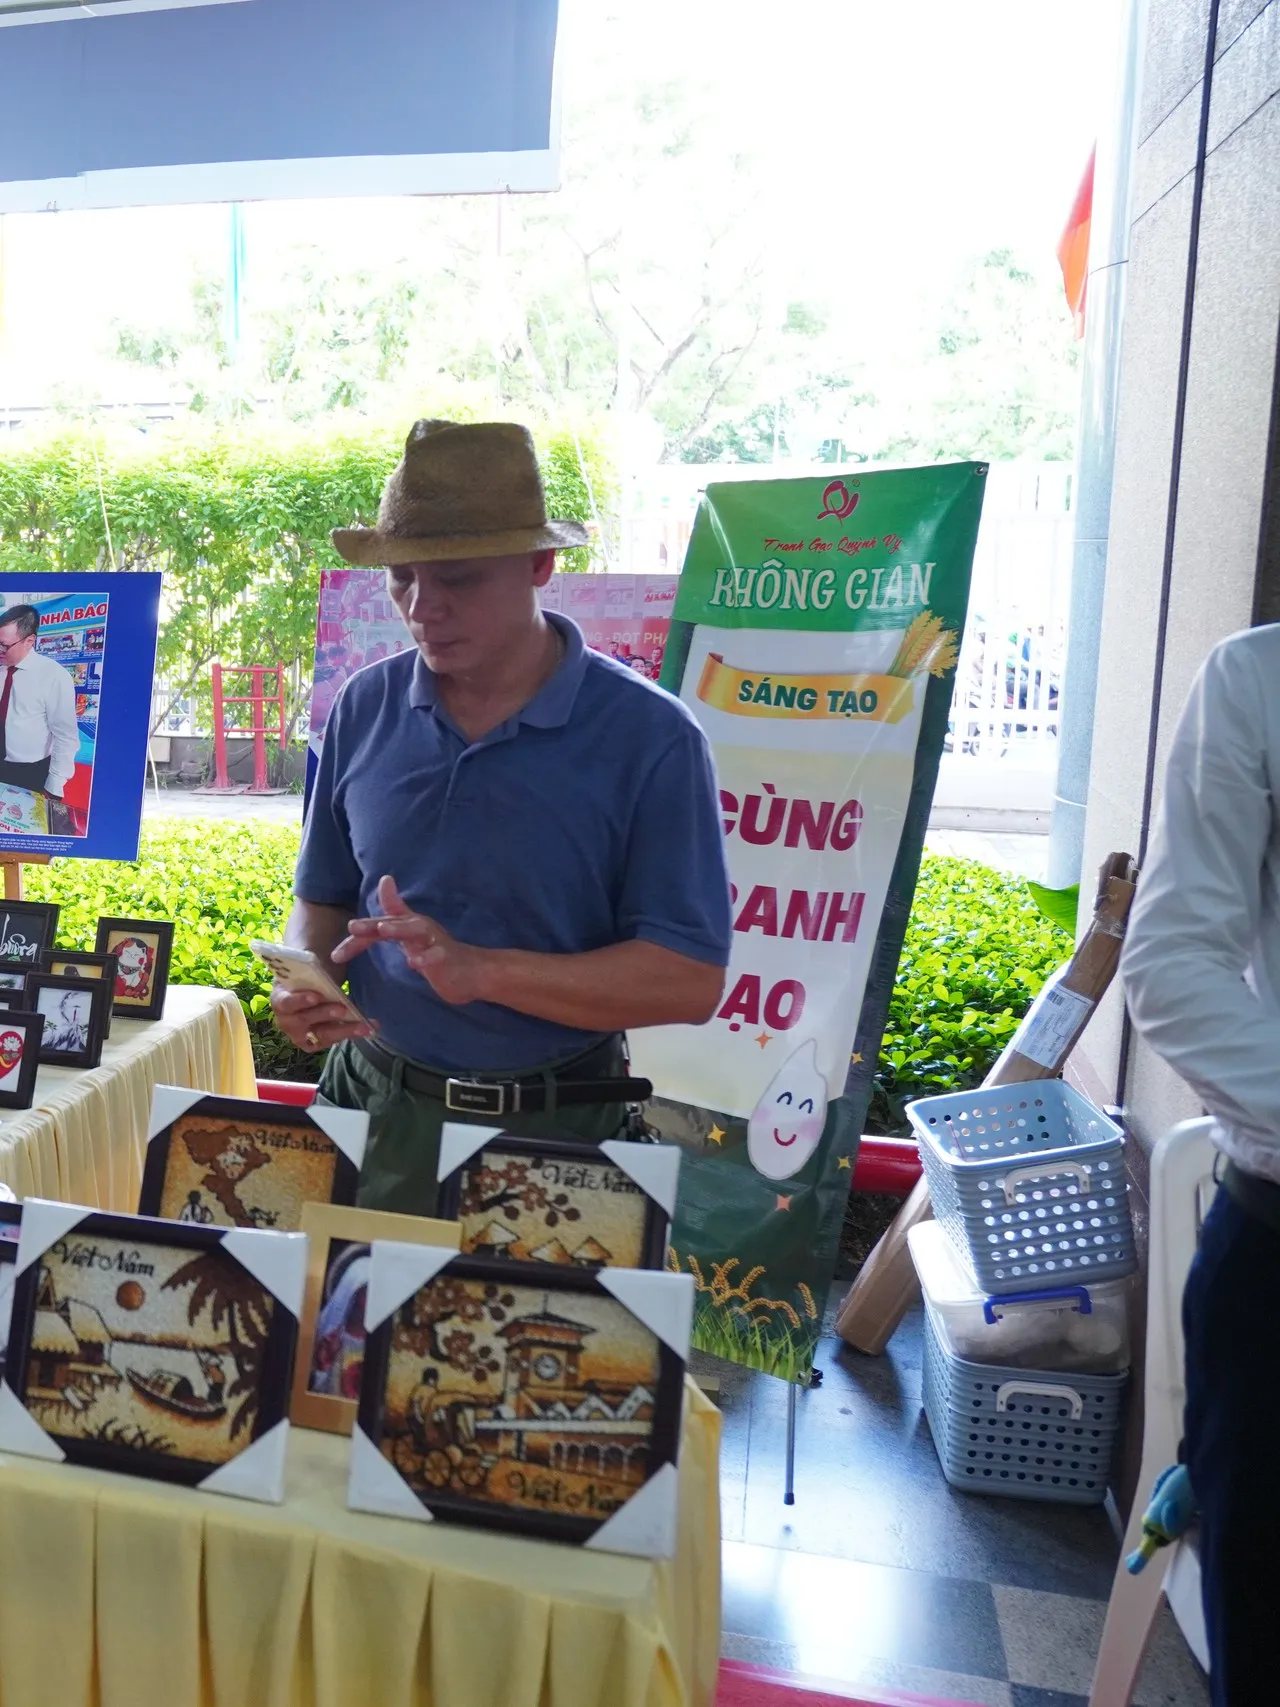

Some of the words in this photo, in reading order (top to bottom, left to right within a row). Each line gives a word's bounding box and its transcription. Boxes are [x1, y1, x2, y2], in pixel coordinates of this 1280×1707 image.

[764, 537, 805, 553] Tranh
[837, 535, 877, 557] Quỳnh
[882, 533, 904, 555] Vy
[709, 559, 836, 610] KHÔNG
[844, 562, 937, 610] GIAN
[738, 677, 819, 711] SÁNG
[827, 690, 878, 718] TẠO
[728, 883, 866, 943] ANH
[717, 974, 806, 1032] ẠO
